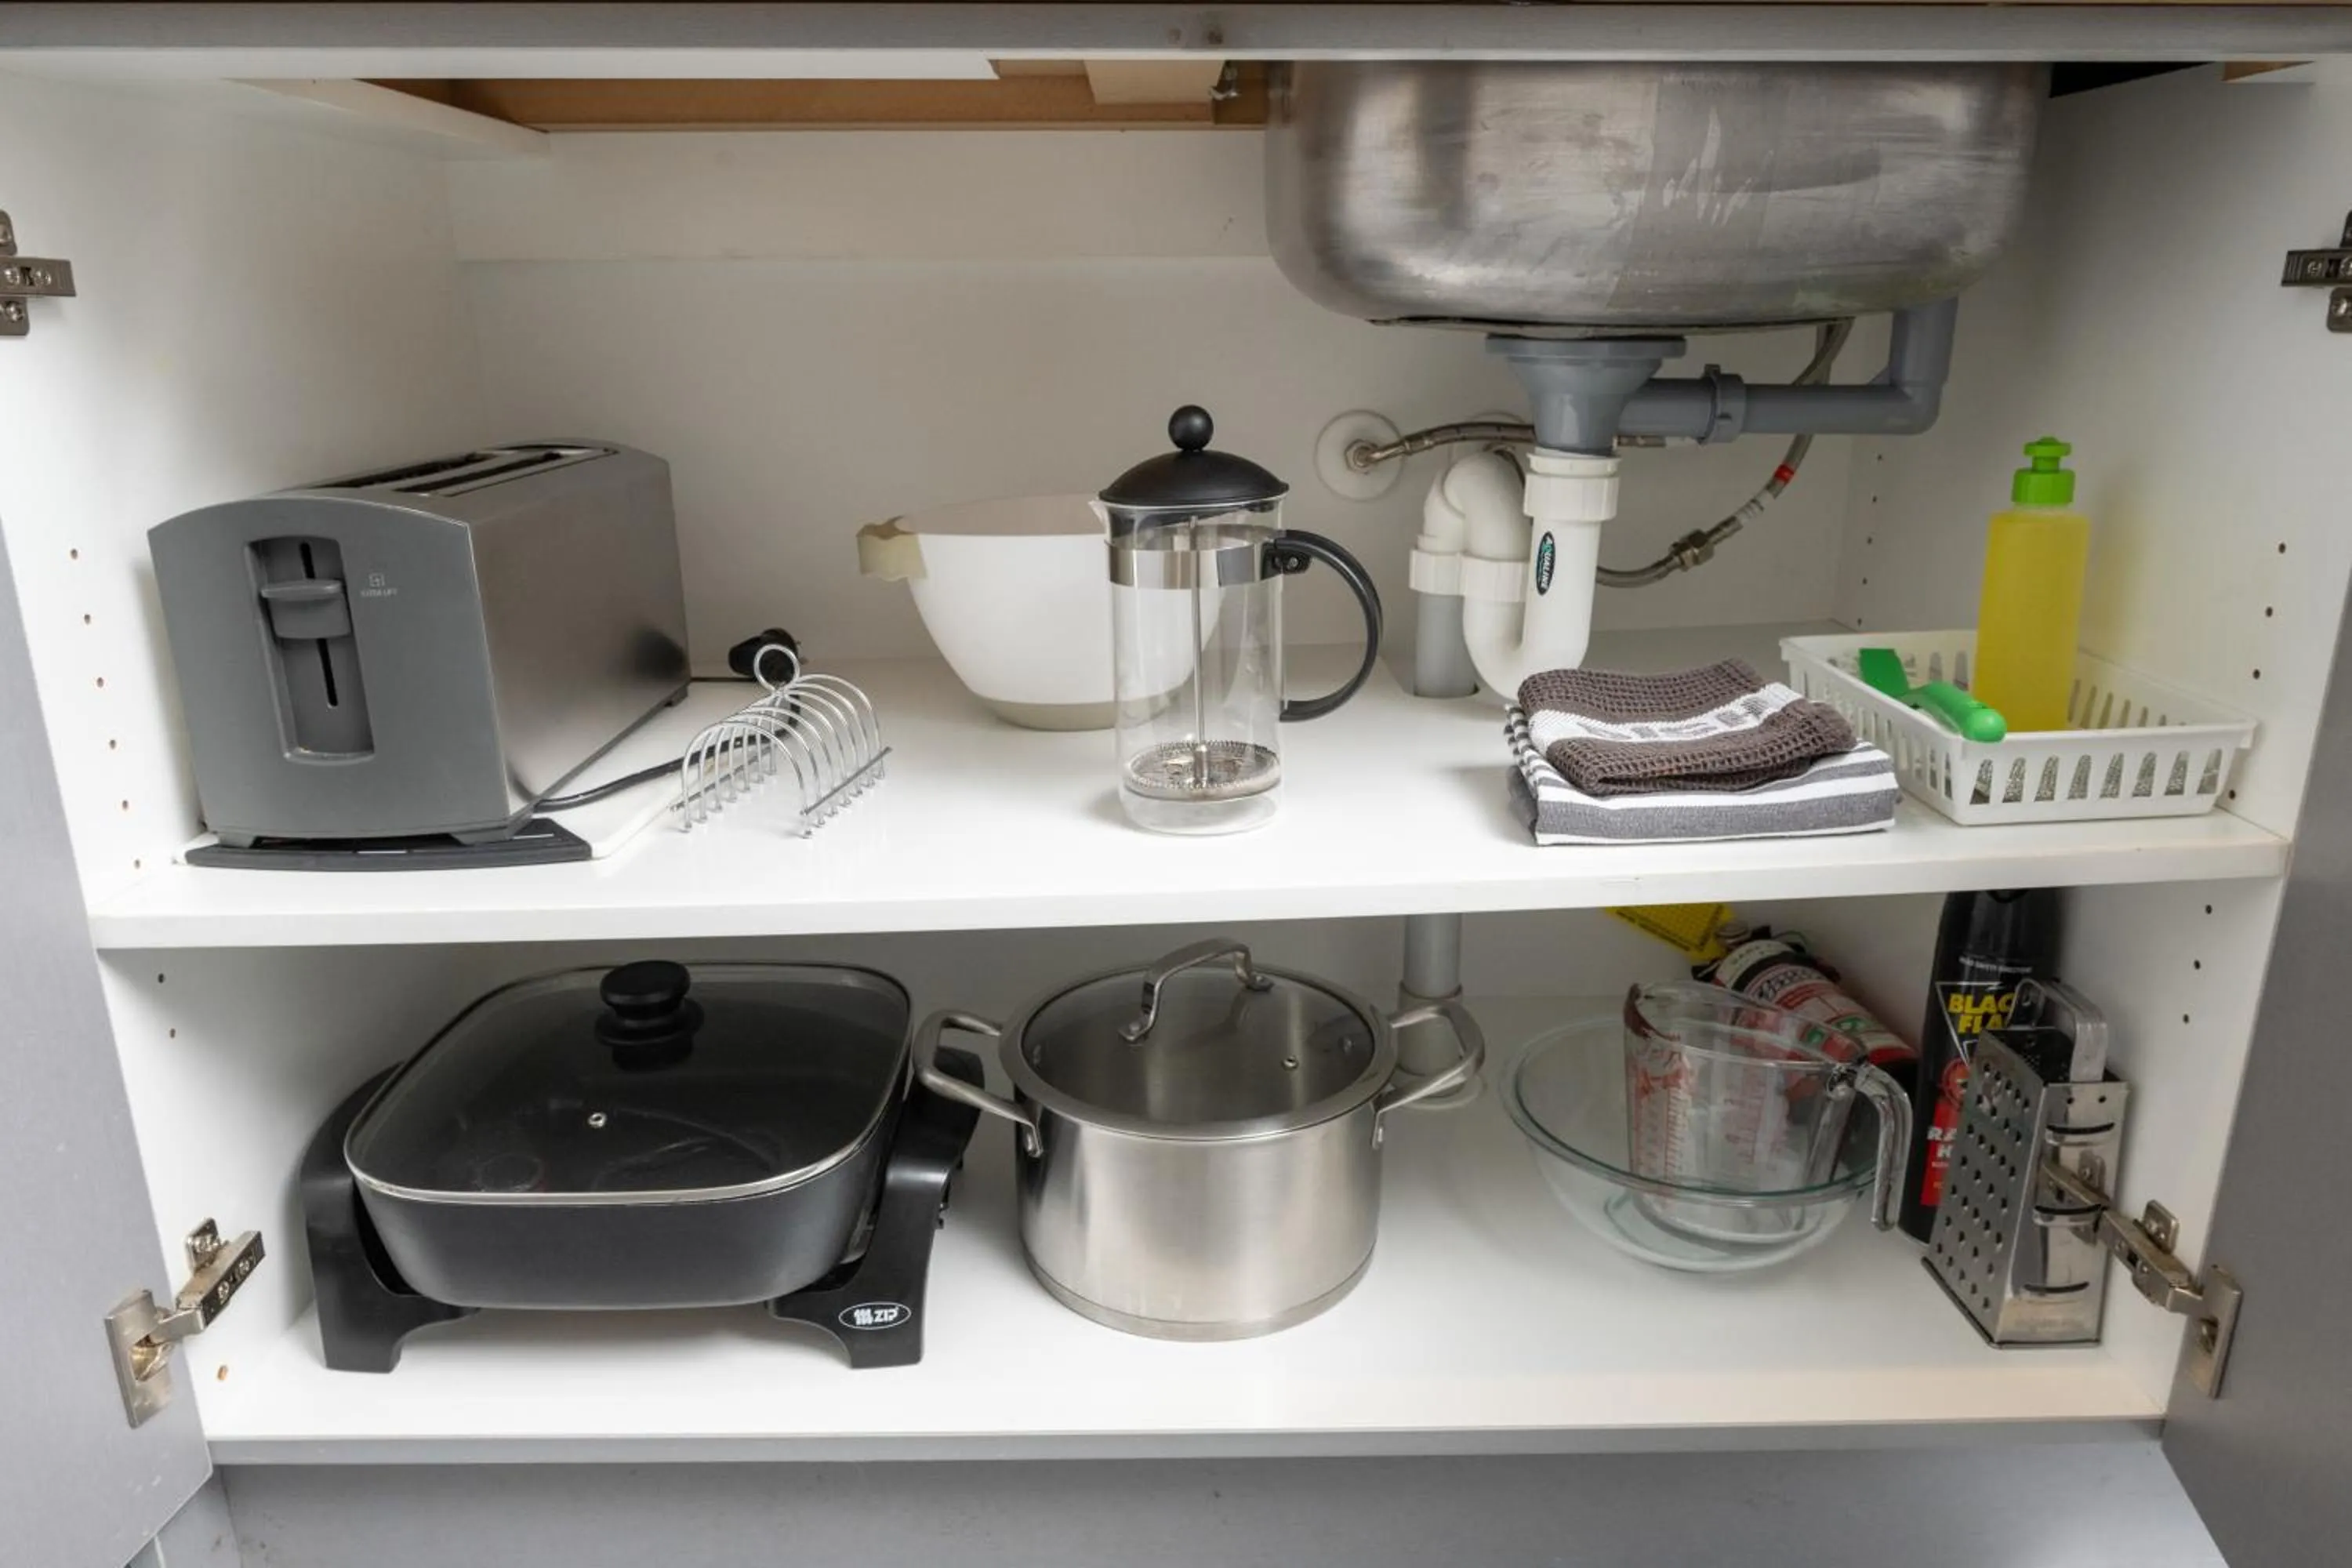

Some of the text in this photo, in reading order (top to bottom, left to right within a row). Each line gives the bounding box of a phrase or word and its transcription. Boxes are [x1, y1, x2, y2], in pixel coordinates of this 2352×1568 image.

[1948, 993, 2015, 1013] BLAC
[1958, 1014, 2004, 1033] FLA
[873, 1307, 898, 1323] ZIP
